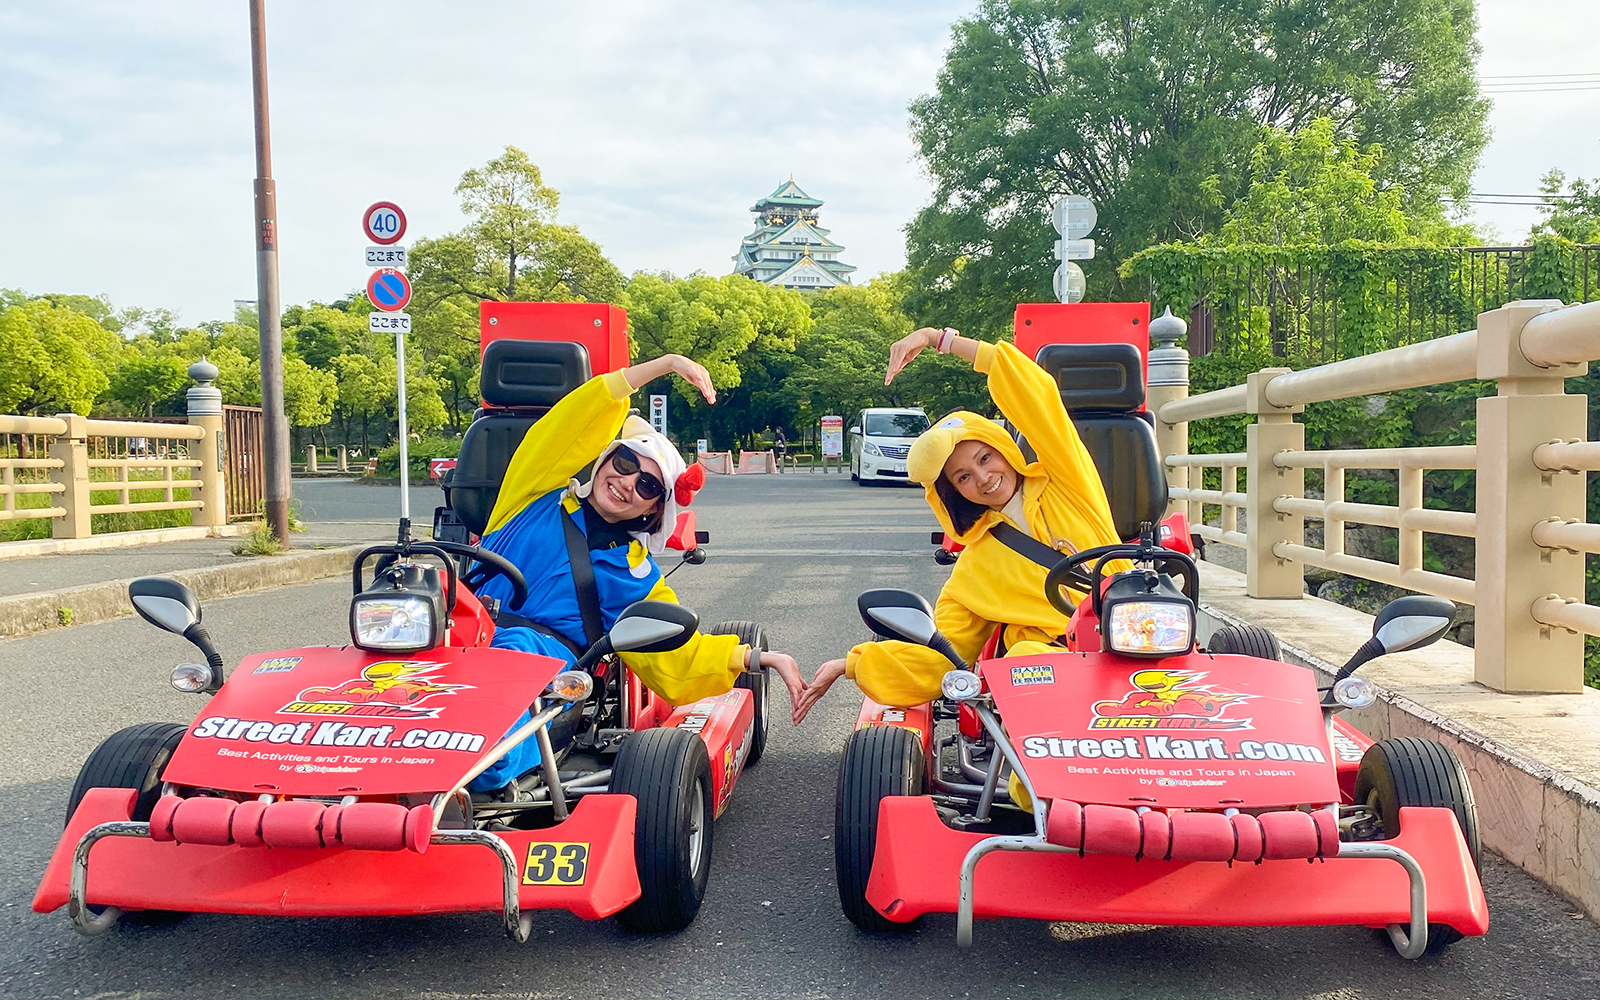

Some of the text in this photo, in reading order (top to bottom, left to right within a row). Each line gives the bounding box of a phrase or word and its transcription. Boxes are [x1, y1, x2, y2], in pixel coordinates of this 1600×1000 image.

[373, 213, 397, 233] 40
[367, 251, 404, 262] ここまで
[371, 317, 409, 329] ここまで
[217, 748, 435, 765] Best Activities and Tours in Japan
[278, 764, 293, 772] by
[1067, 766, 1296, 777] Best Activities and Tours in Japan
[1139, 777, 1153, 785] by
[527, 844, 587, 882] 33
